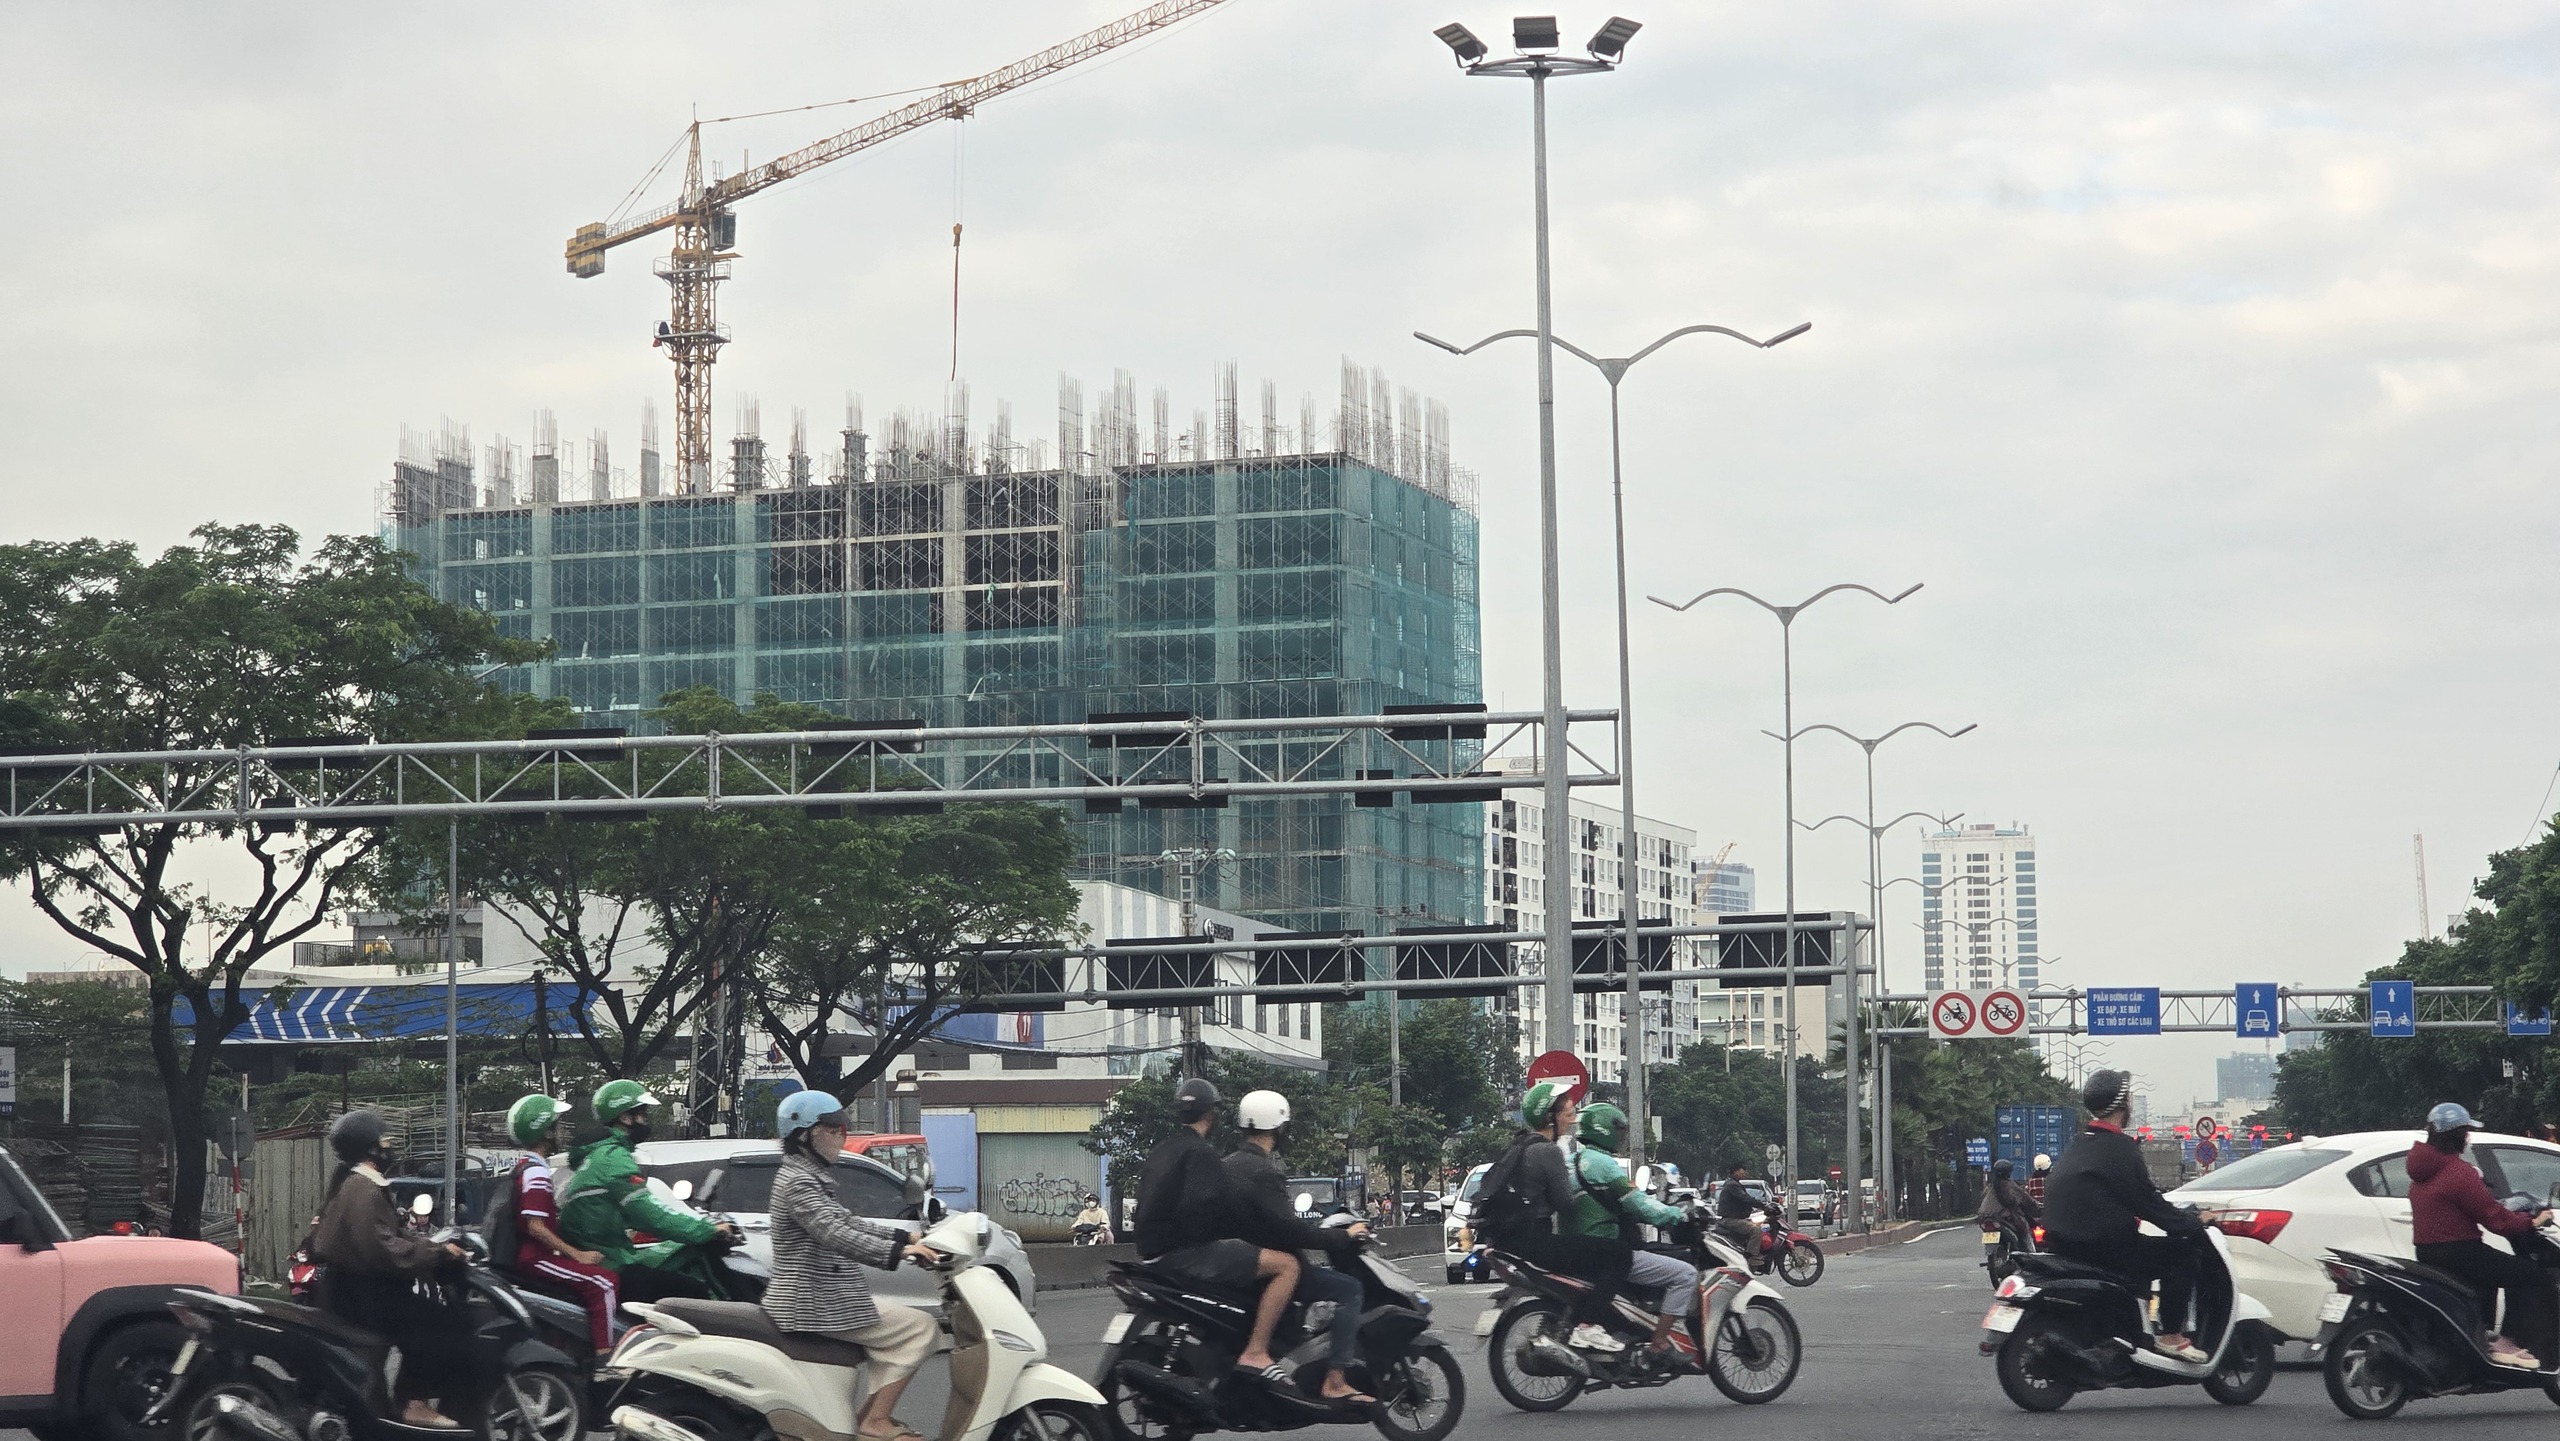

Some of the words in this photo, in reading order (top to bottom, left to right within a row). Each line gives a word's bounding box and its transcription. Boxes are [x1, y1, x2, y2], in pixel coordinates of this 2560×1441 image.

[2092, 991, 2109, 1002] PHẦN
[2109, 992, 2128, 1002] ĐƯỜNG
[2097, 1005, 2105, 1014] XE
[2120, 1005, 2127, 1014] XE
[2128, 1004, 2141, 1014] MÁY
[2097, 1018, 2105, 1026] XE
[2127, 1016, 2139, 1026] CÁC
[2139, 1017, 2153, 1027] LOẠI
